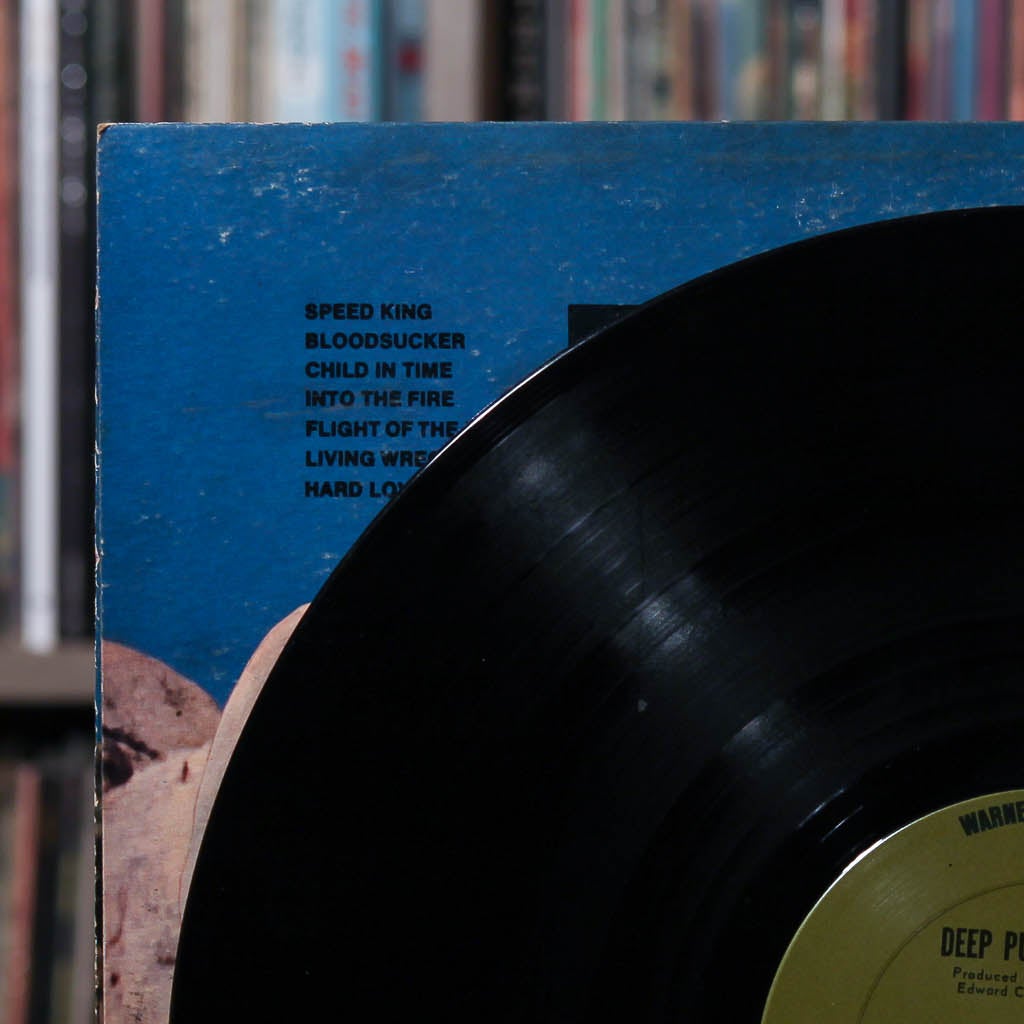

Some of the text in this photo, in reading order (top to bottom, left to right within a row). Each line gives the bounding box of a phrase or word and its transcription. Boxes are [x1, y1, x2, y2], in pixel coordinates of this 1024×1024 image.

[305, 303, 432, 320] SPEED KING
[305, 332, 465, 350] BLOODSUCKER
[305, 361, 453, 379] CHILD IN TIME
[305, 390, 455, 407] INTO THE FIRE
[305, 420, 459, 437] FLIGHT OF THE
[305, 450, 375, 467] LIVING
[304, 481, 363, 498] HARD
[941, 926, 993, 959] DEEP
[952, 966, 1017, 983] Produced
[956, 981, 1008, 997] Edward
